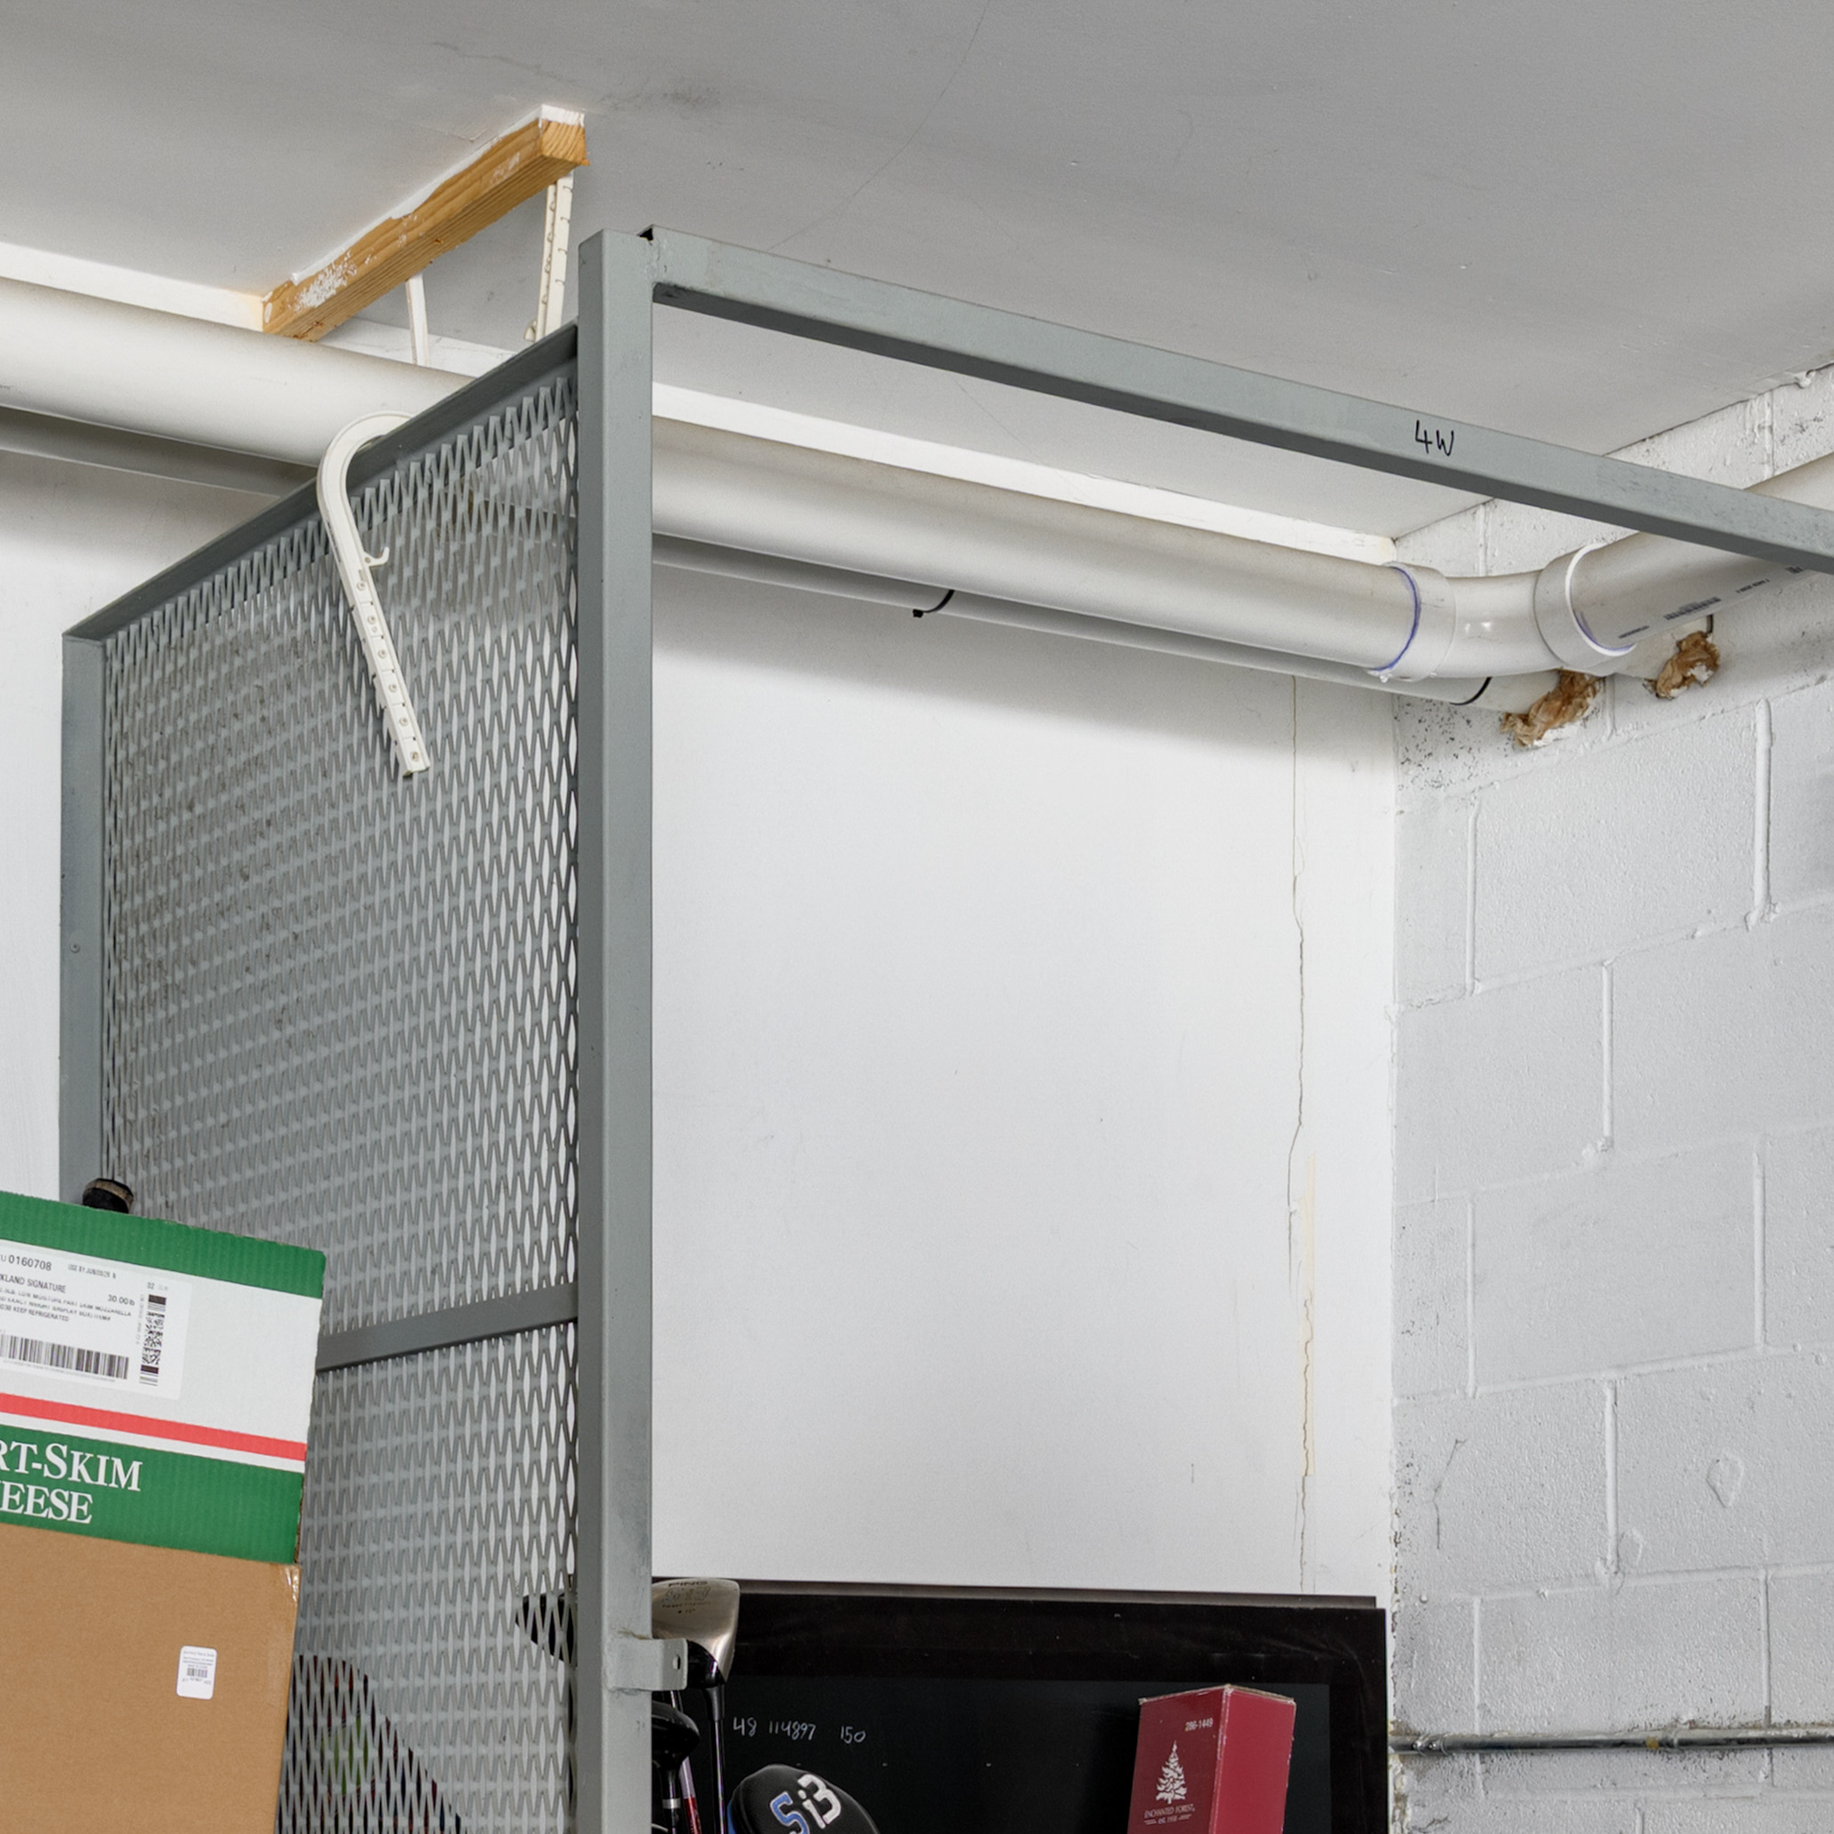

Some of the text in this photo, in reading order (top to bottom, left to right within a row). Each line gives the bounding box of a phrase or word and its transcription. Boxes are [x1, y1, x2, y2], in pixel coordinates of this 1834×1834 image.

[1413, 419, 1456, 459] 4W
[7, 1254, 52, 1271] 0160708
[27, 1278, 65, 1293] SIGNATURE
[732, 1716, 757, 1737] 48
[840, 1726, 866, 1744] 150
